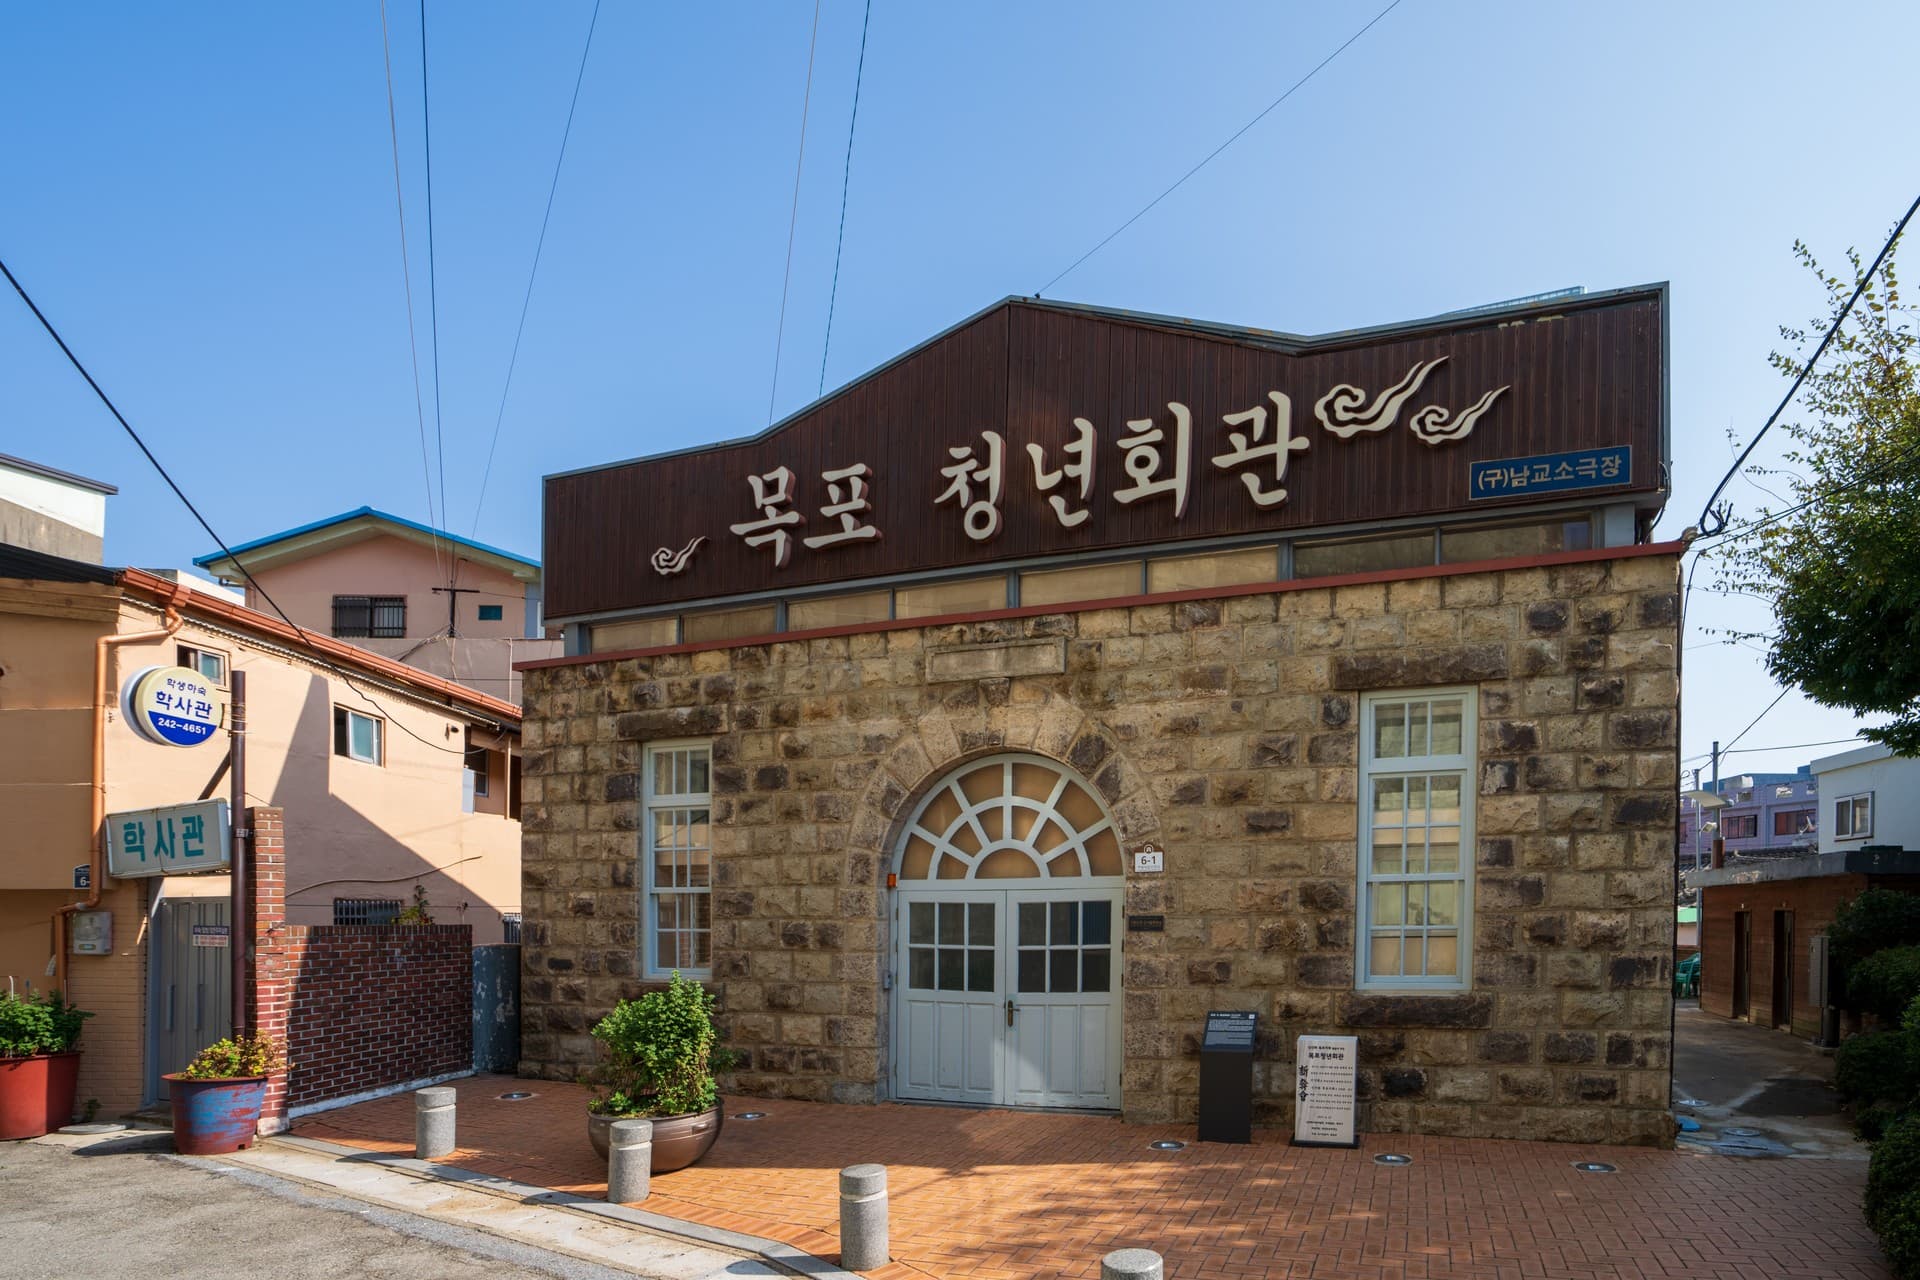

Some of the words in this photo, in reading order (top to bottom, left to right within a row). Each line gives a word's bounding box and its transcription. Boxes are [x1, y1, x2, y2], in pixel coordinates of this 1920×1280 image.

[730, 463, 877, 567] 목포
[934, 391, 1310, 540] 청년회관
[1478, 454, 1623, 490] (구)남교소극장
[166, 678, 207, 696] 학생하숙
[155, 690, 213, 720] 학사관
[158, 717, 206, 735] 242-4651
[123, 814, 204, 862] 학사관
[1141, 855, 1156, 865] 6-1
[80, 876, 91, 886] 6-
